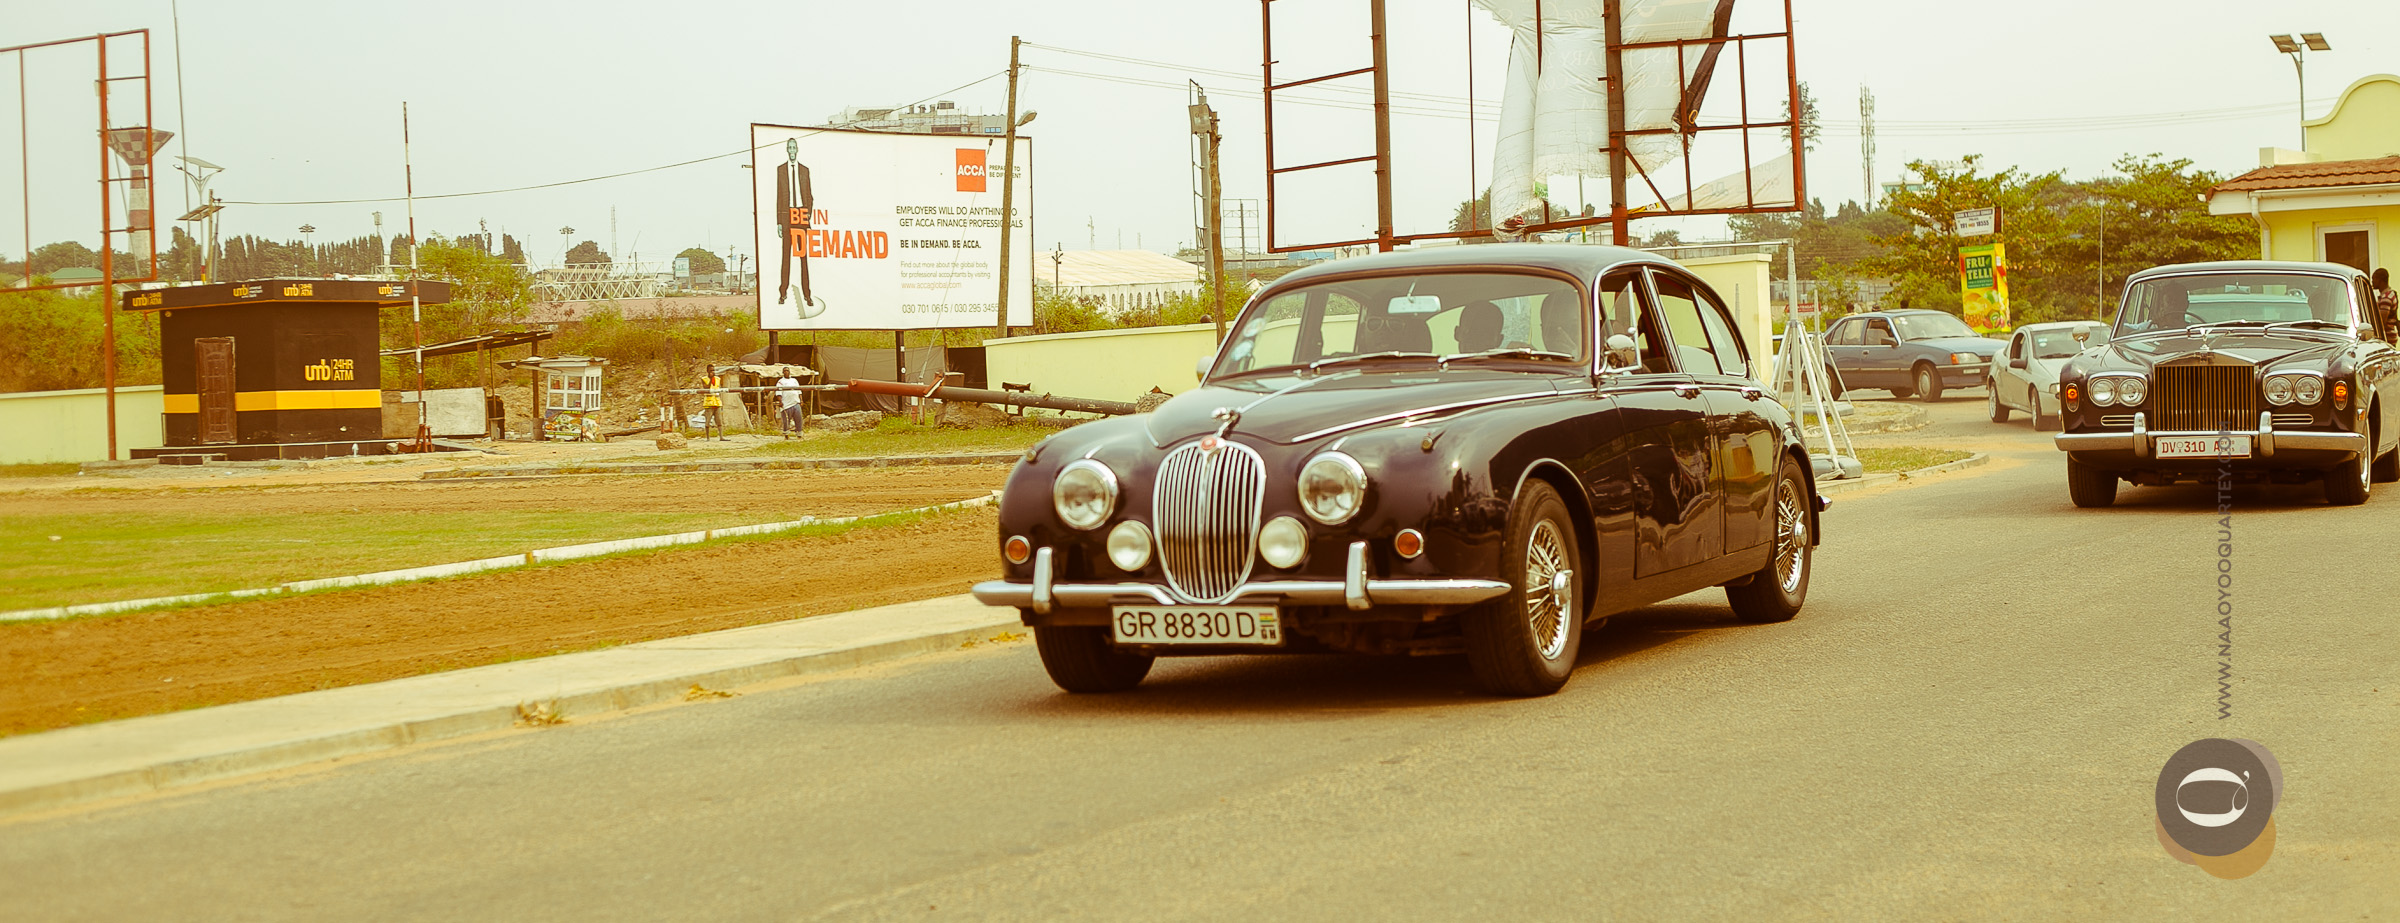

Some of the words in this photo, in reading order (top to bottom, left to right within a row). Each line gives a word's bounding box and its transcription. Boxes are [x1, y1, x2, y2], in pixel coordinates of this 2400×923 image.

[957, 164, 985, 177] ACCA
[789, 207, 809, 225] BE
[813, 208, 828, 225] IN
[896, 205, 937, 215] EMPLOYERS
[938, 206, 955, 215] WILL
[956, 206, 968, 215] DO
[899, 218, 914, 227] GET
[915, 218, 935, 228] ACCA
[936, 218, 968, 228] FINANCE
[969, 219, 1024, 228] PROFESSIALS
[790, 228, 889, 259] DEMAND
[900, 239, 909, 249] BE
[911, 239, 919, 249] IN
[920, 239, 951, 249] DEMAND.
[952, 239, 961, 249] BE
[962, 240, 982, 249] ACCA.
[900, 260, 912, 268] Find
[960, 261, 975, 270] global
[976, 261, 988, 270] body
[900, 270, 908, 278] for
[908, 270, 938, 279] professional
[967, 271, 974, 280] by
[1966, 268, 1992, 280] TELLI
[283, 283, 299, 297] umb
[902, 303, 916, 314] 030
[917, 303, 930, 313] 701
[931, 303, 949, 313] 0615
[954, 303, 968, 313] 030
[968, 303, 982, 313] 295
[304, 358, 331, 381] umb
[332, 358, 354, 370] 24HR
[333, 369, 355, 381] ATM
[2161, 441, 2176, 454] DV
[2184, 440, 2206, 453] 310
[1119, 611, 1157, 638] GR
[1164, 612, 1231, 639] 8830
[1236, 612, 1256, 638] D
[1260, 628, 1277, 640] GH
